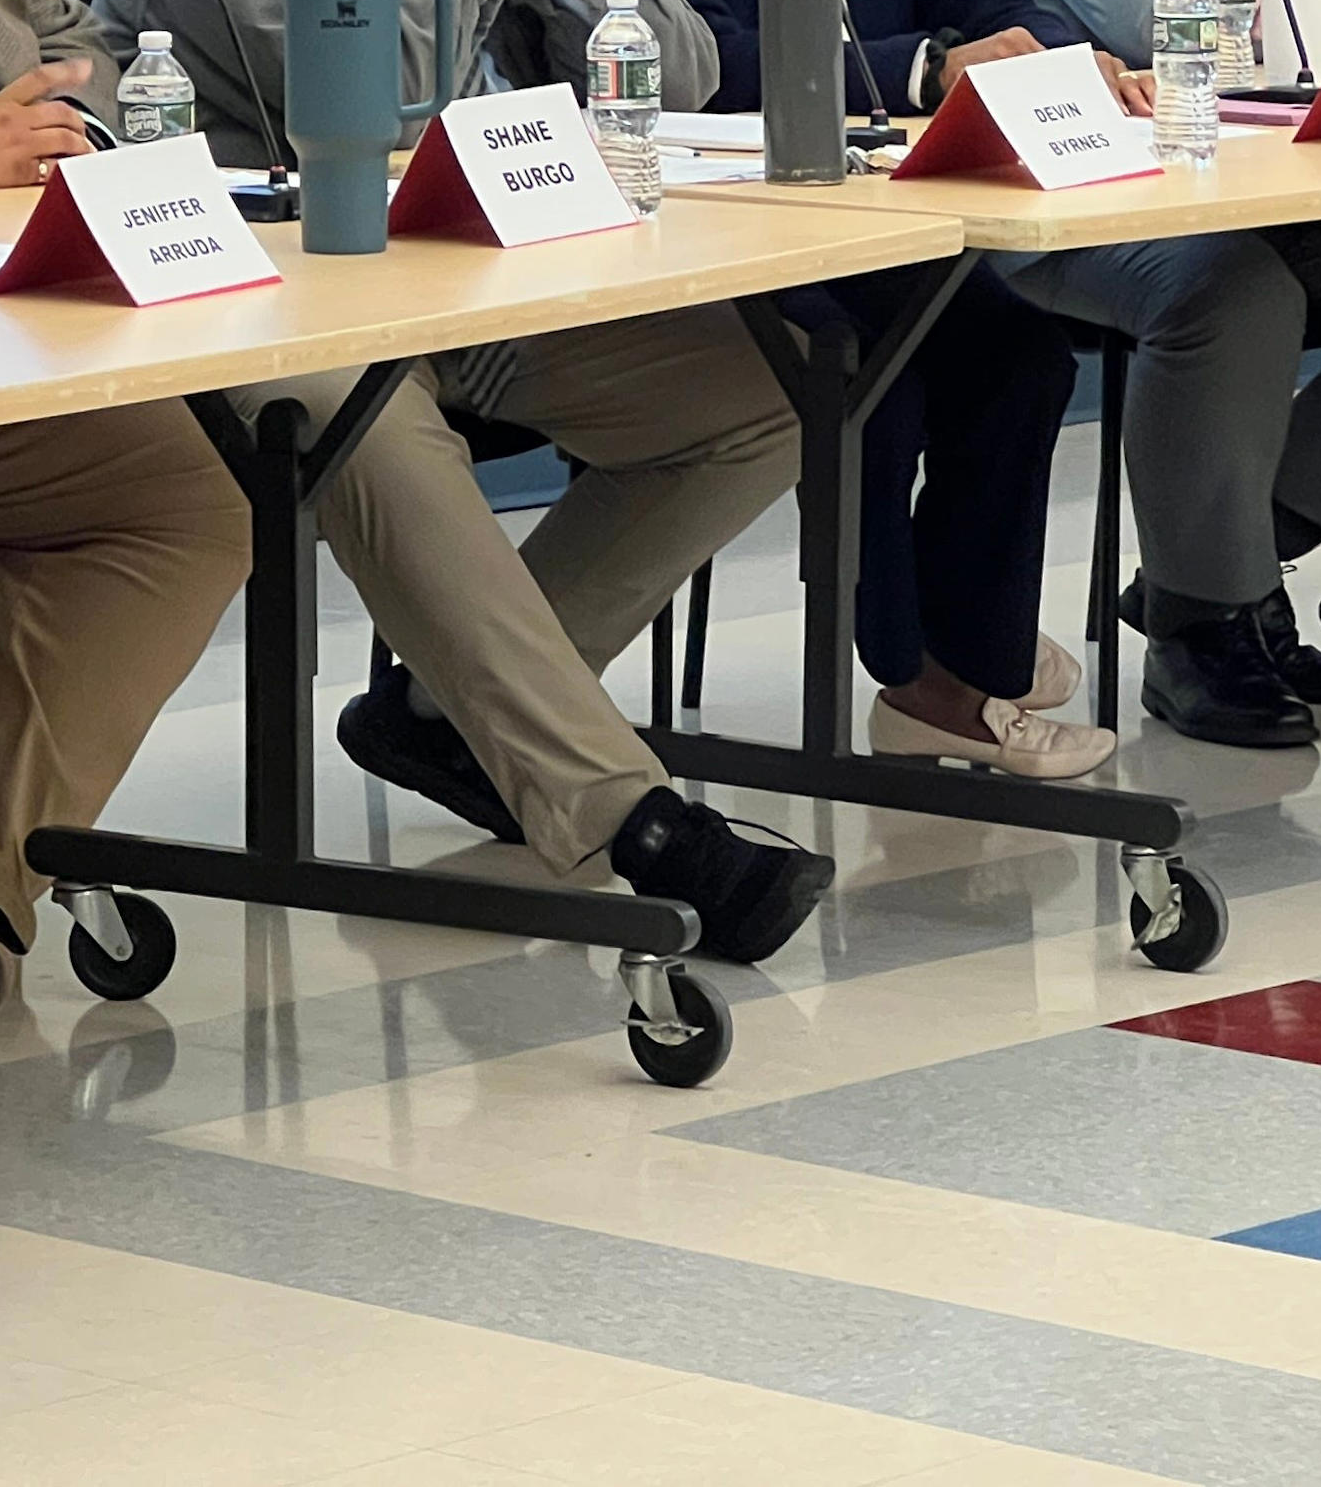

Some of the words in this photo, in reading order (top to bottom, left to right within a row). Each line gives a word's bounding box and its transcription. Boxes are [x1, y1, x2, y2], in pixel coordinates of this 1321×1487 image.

[1034, 103, 1081, 125] DEVIN
[483, 120, 553, 150] SHANE
[1048, 133, 1111, 156] BYRNES
[502, 163, 576, 193] BURGO
[123, 198, 207, 229] JENIFFER
[149, 236, 223, 265] ARRUDA
